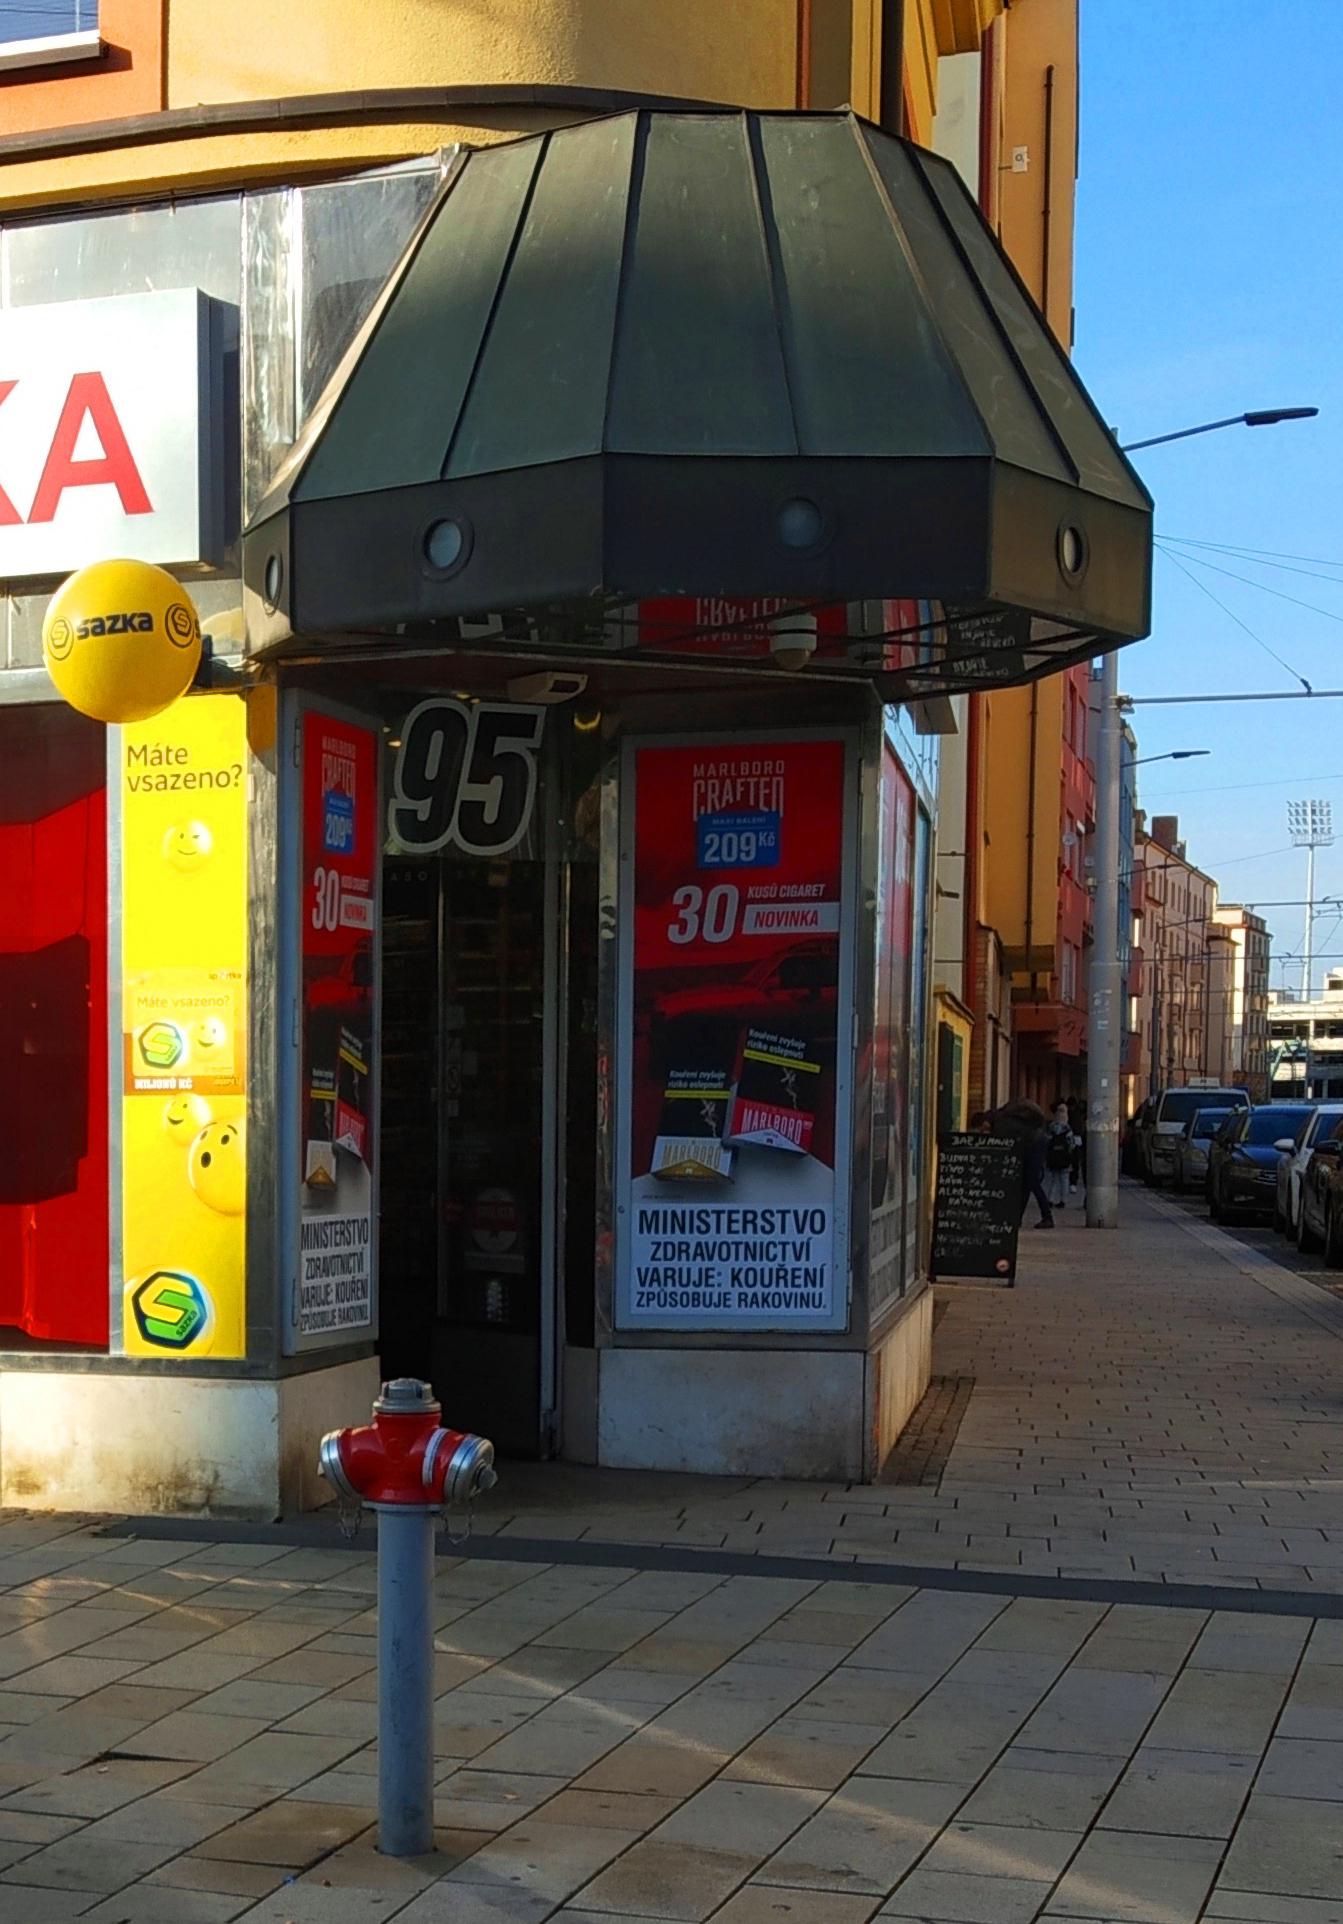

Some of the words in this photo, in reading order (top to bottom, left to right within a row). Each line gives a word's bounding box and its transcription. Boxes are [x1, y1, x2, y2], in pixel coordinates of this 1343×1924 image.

[127, 742, 188, 768] Máte
[127, 765, 243, 793] vsazeno?
[387, 697, 548, 857] 95
[693, 760, 785, 778] MARLBORO
[693, 776, 785, 822] CRAFTED
[704, 832, 757, 863] 209
[758, 831, 776, 847] Kč
[312, 866, 340, 932] 30
[747, 883, 778, 899] KUSŮ
[779, 884, 826, 898] CIGARET
[667, 884, 740, 944] 30
[754, 910, 820, 929] NOVINKA
[137, 995, 168, 1009] Máte
[173, 994, 230, 1008] vsazeno?
[741, 1107, 803, 1145] MARLBORO
[661, 1144, 722, 1170] MARLBORO
[300, 1217, 369, 1250] MINISTERSTVO
[638, 1209, 827, 1236] MINISTERSTVO
[650, 1237, 813, 1263] ZDRAVOTNICTVÍ
[305, 1247, 365, 1281] ZDRAVOTNICTVÍ
[636, 1266, 723, 1289] VARUJE:
[730, 1263, 827, 1289] KOUŘENÍ
[301, 1284, 333, 1309] VARUJE:
[335, 1273, 369, 1304] KOUŘENÍ
[636, 1288, 732, 1309] ZPŮSOBUJE
[737, 1291, 827, 1309] RAKOVINU.
